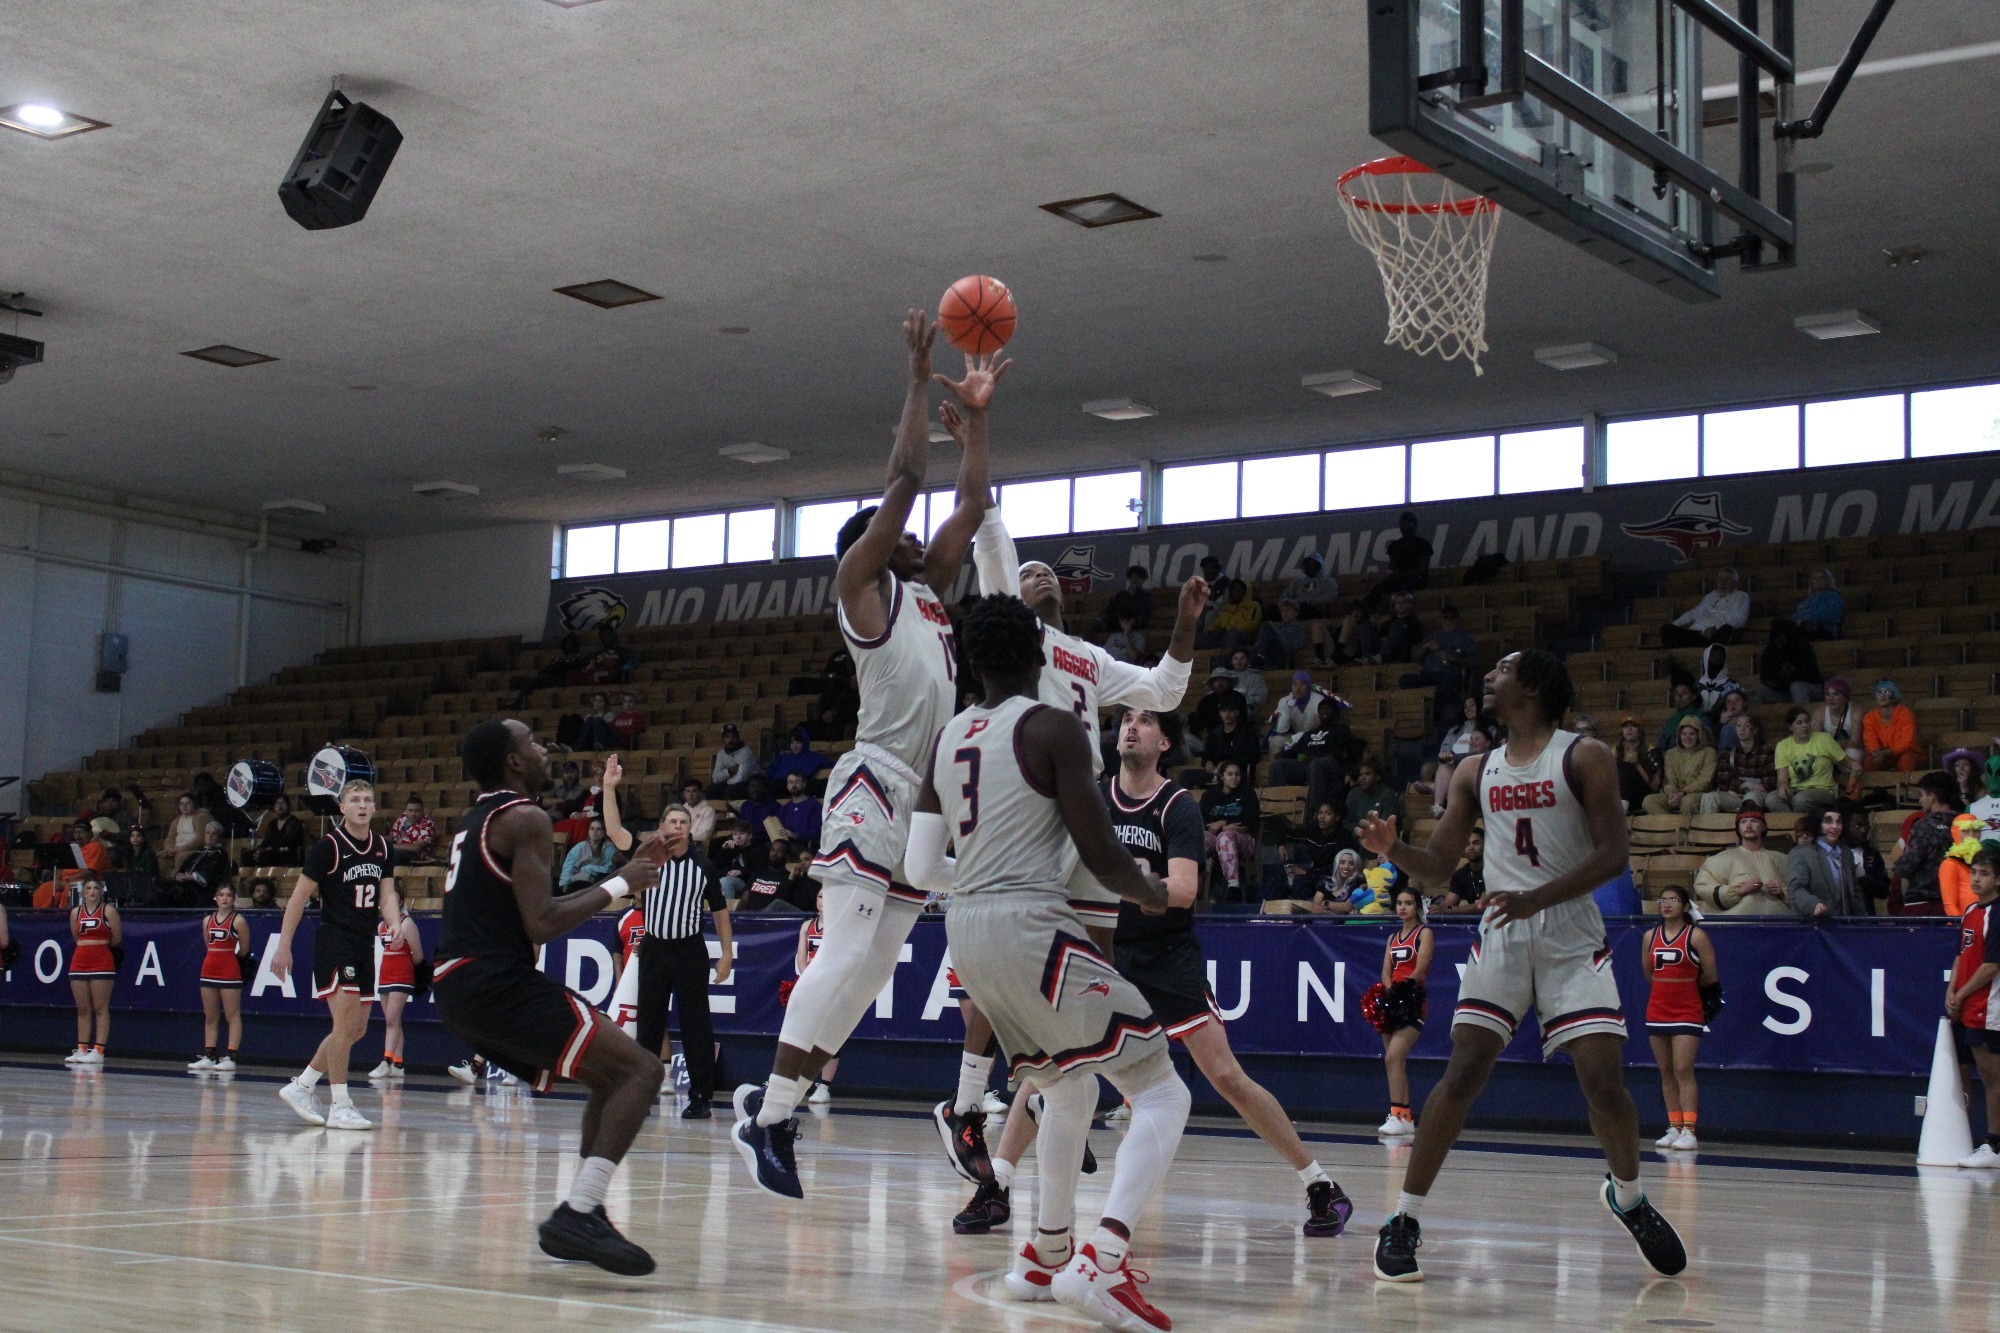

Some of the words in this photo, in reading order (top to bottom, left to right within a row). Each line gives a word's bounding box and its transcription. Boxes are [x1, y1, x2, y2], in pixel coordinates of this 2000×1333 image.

[1768, 489, 1877, 543] NO
[1126, 543, 1209, 589] NO
[1428, 512, 1603, 568] LAND
[636, 587, 705, 628] NO
[1053, 645, 1097, 686] AGGIES
[953, 746, 982, 837] 3
[1488, 780, 1556, 813] AGGIES
[1514, 817, 1540, 867] 4
[355, 884, 375, 908] 12
